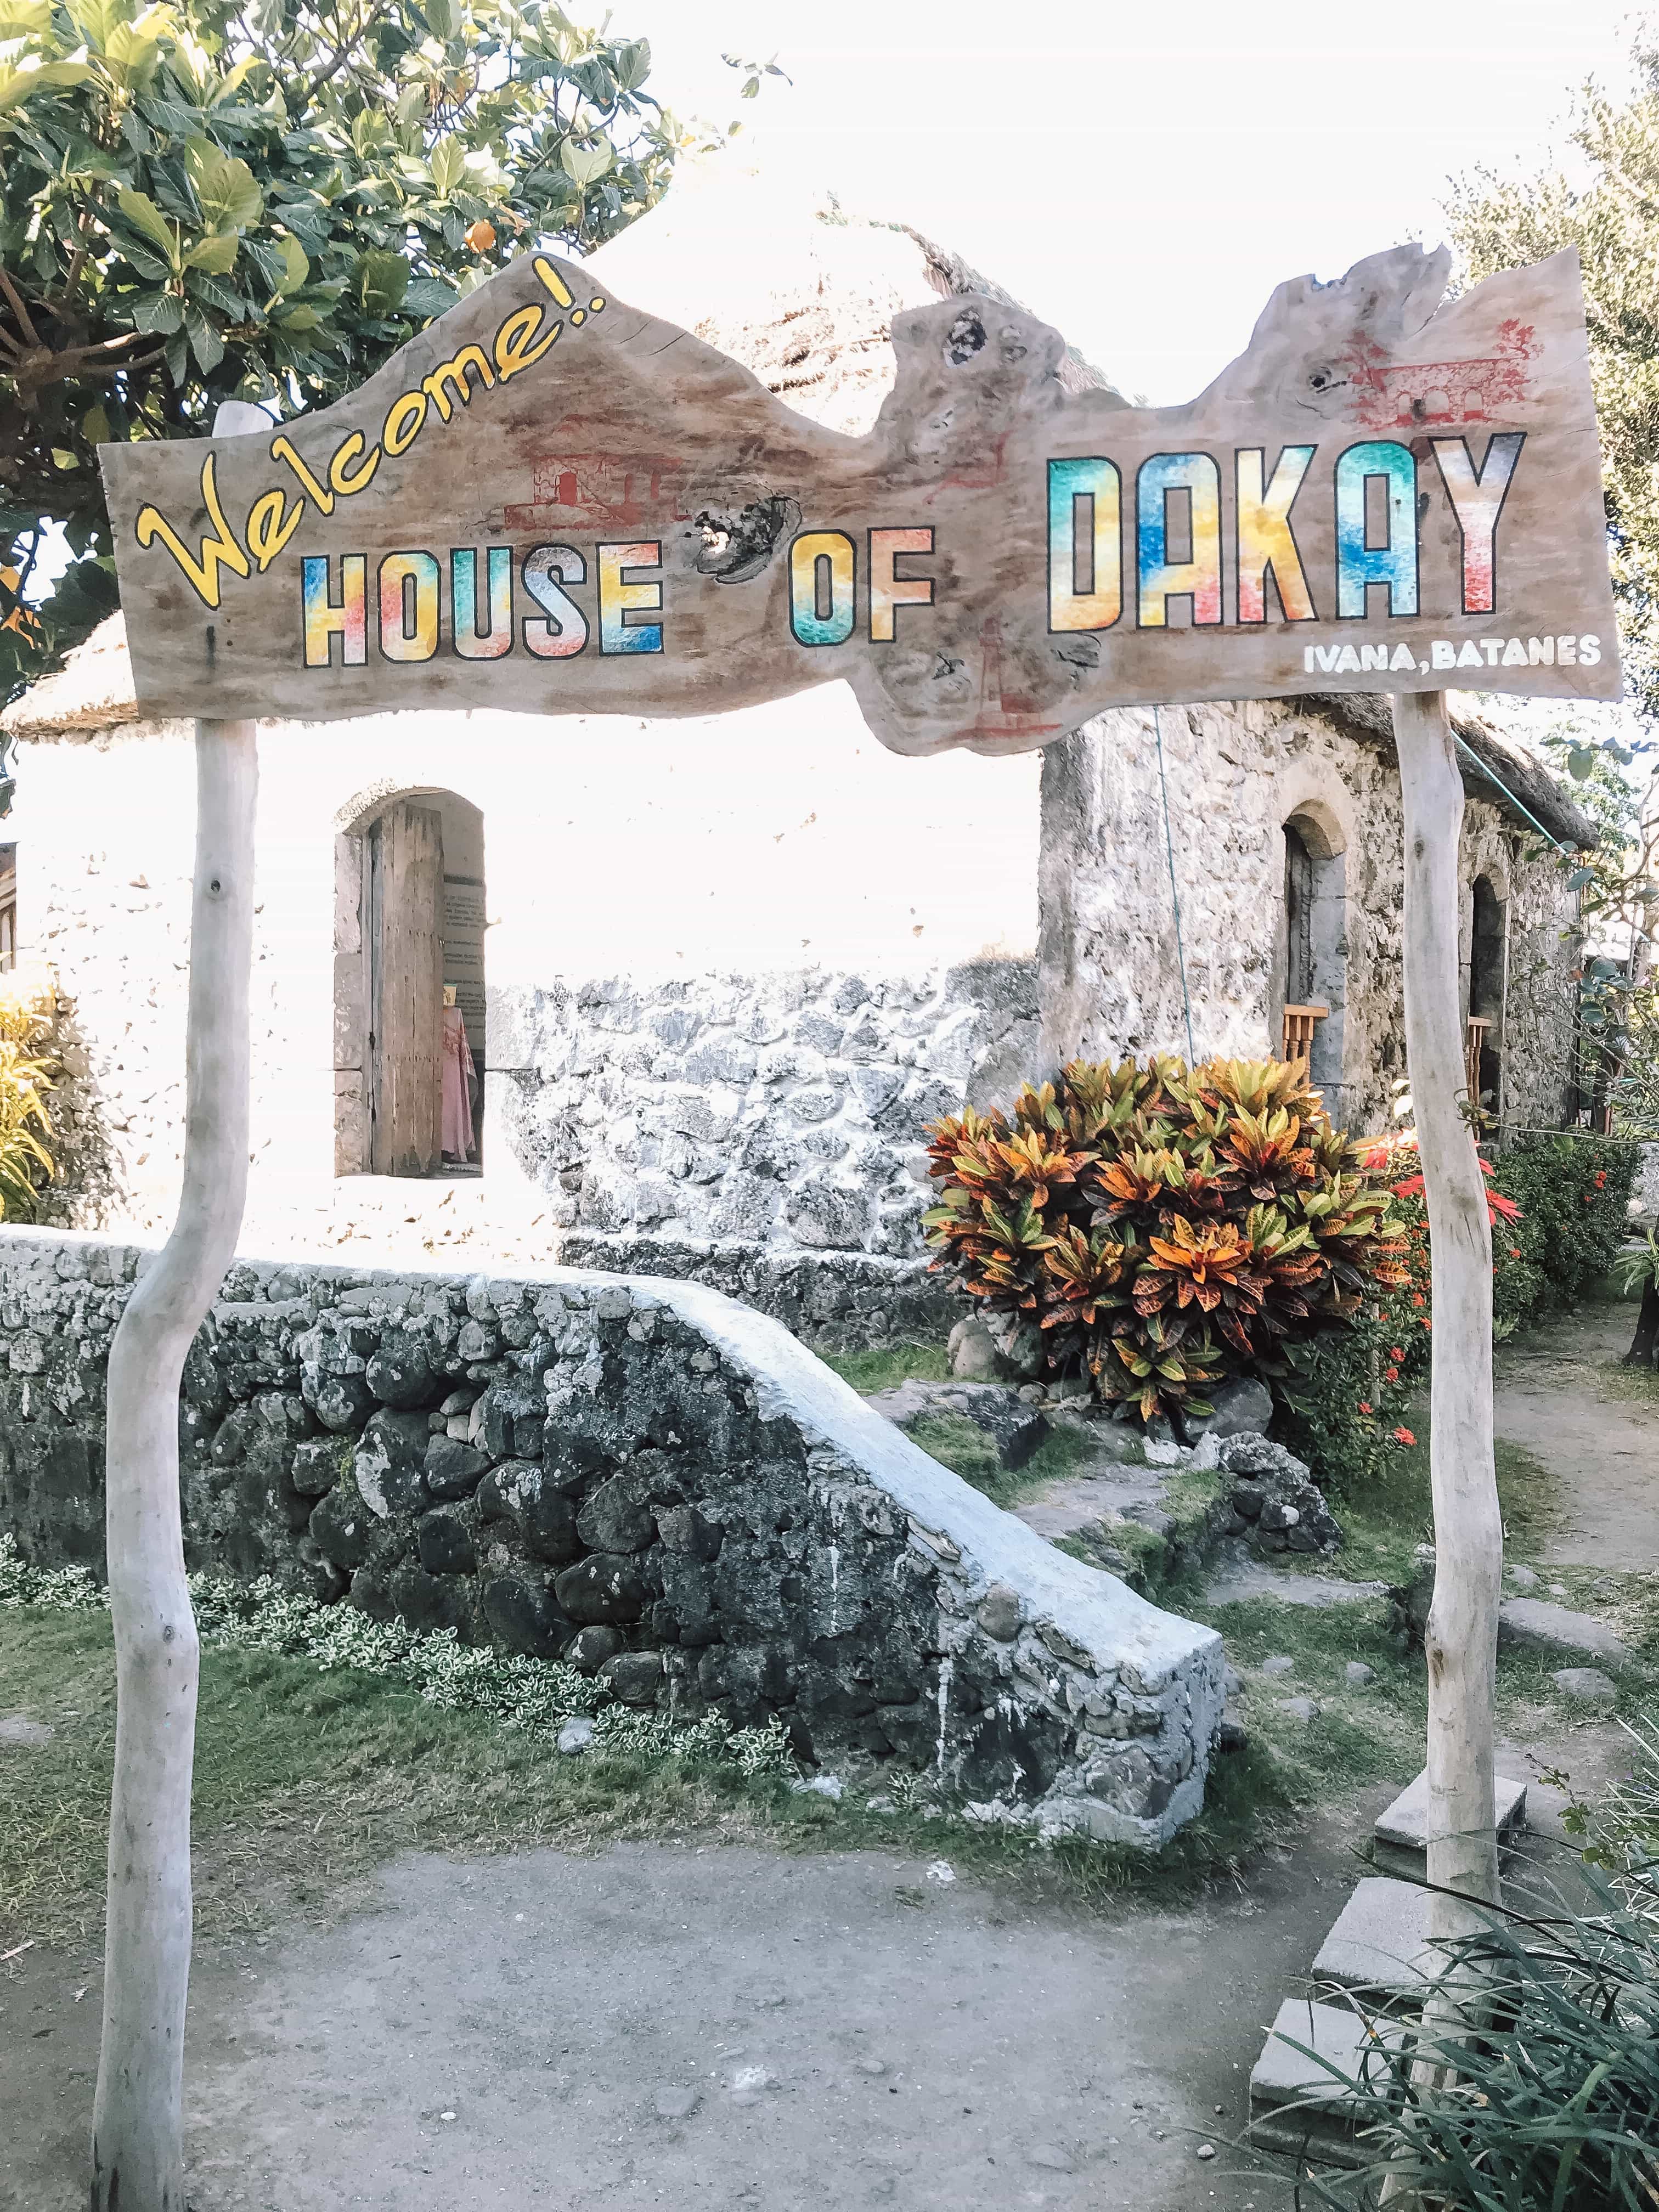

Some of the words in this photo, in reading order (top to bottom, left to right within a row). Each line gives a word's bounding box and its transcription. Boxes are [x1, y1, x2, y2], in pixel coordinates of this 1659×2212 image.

[301, 540, 665, 668] HOUSE
[788, 526, 935, 648] OF
[1047, 431, 1528, 634] DAKAY
